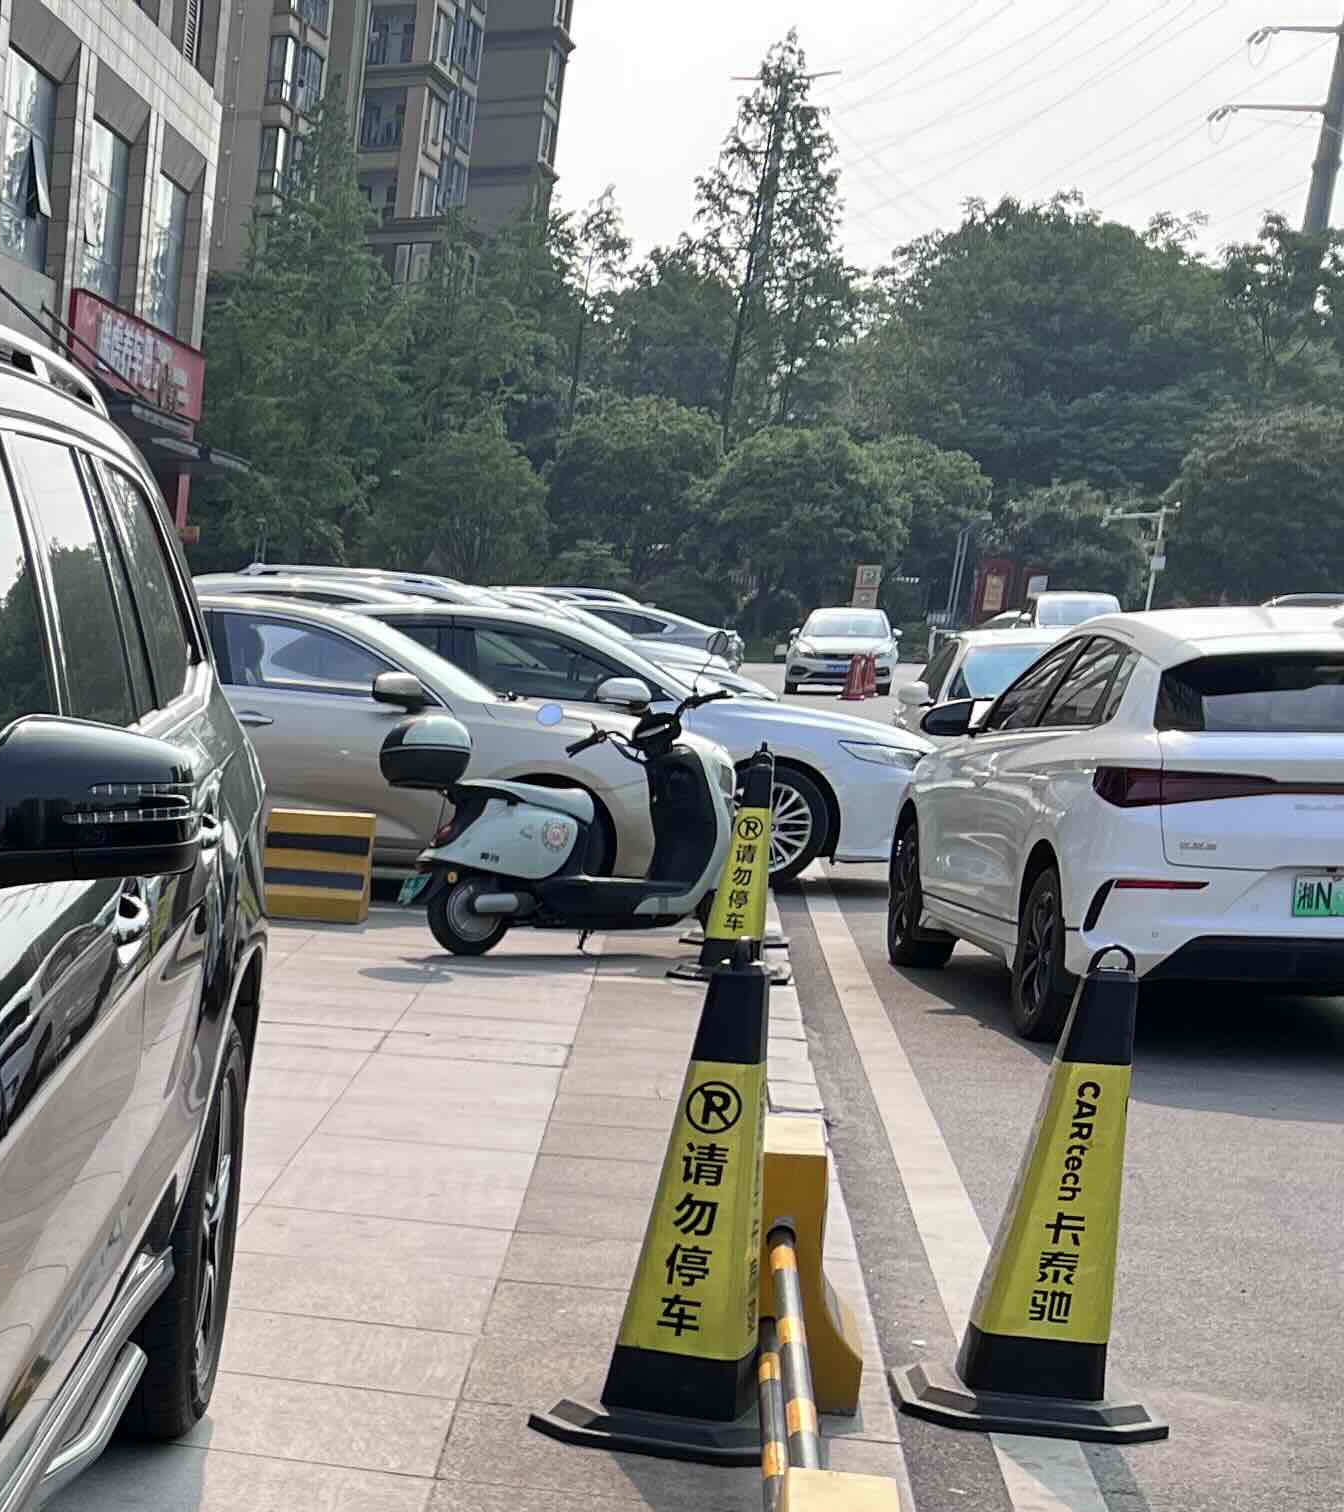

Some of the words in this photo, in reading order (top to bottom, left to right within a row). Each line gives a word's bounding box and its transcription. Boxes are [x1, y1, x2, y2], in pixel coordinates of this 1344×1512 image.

[723, 843, 758, 932] 请勿停车
[1057, 1080, 1102, 1202] CARtech
[656, 1142, 730, 1337] 请勿停车
[1028, 1211, 1086, 1324] 卡泰驰
